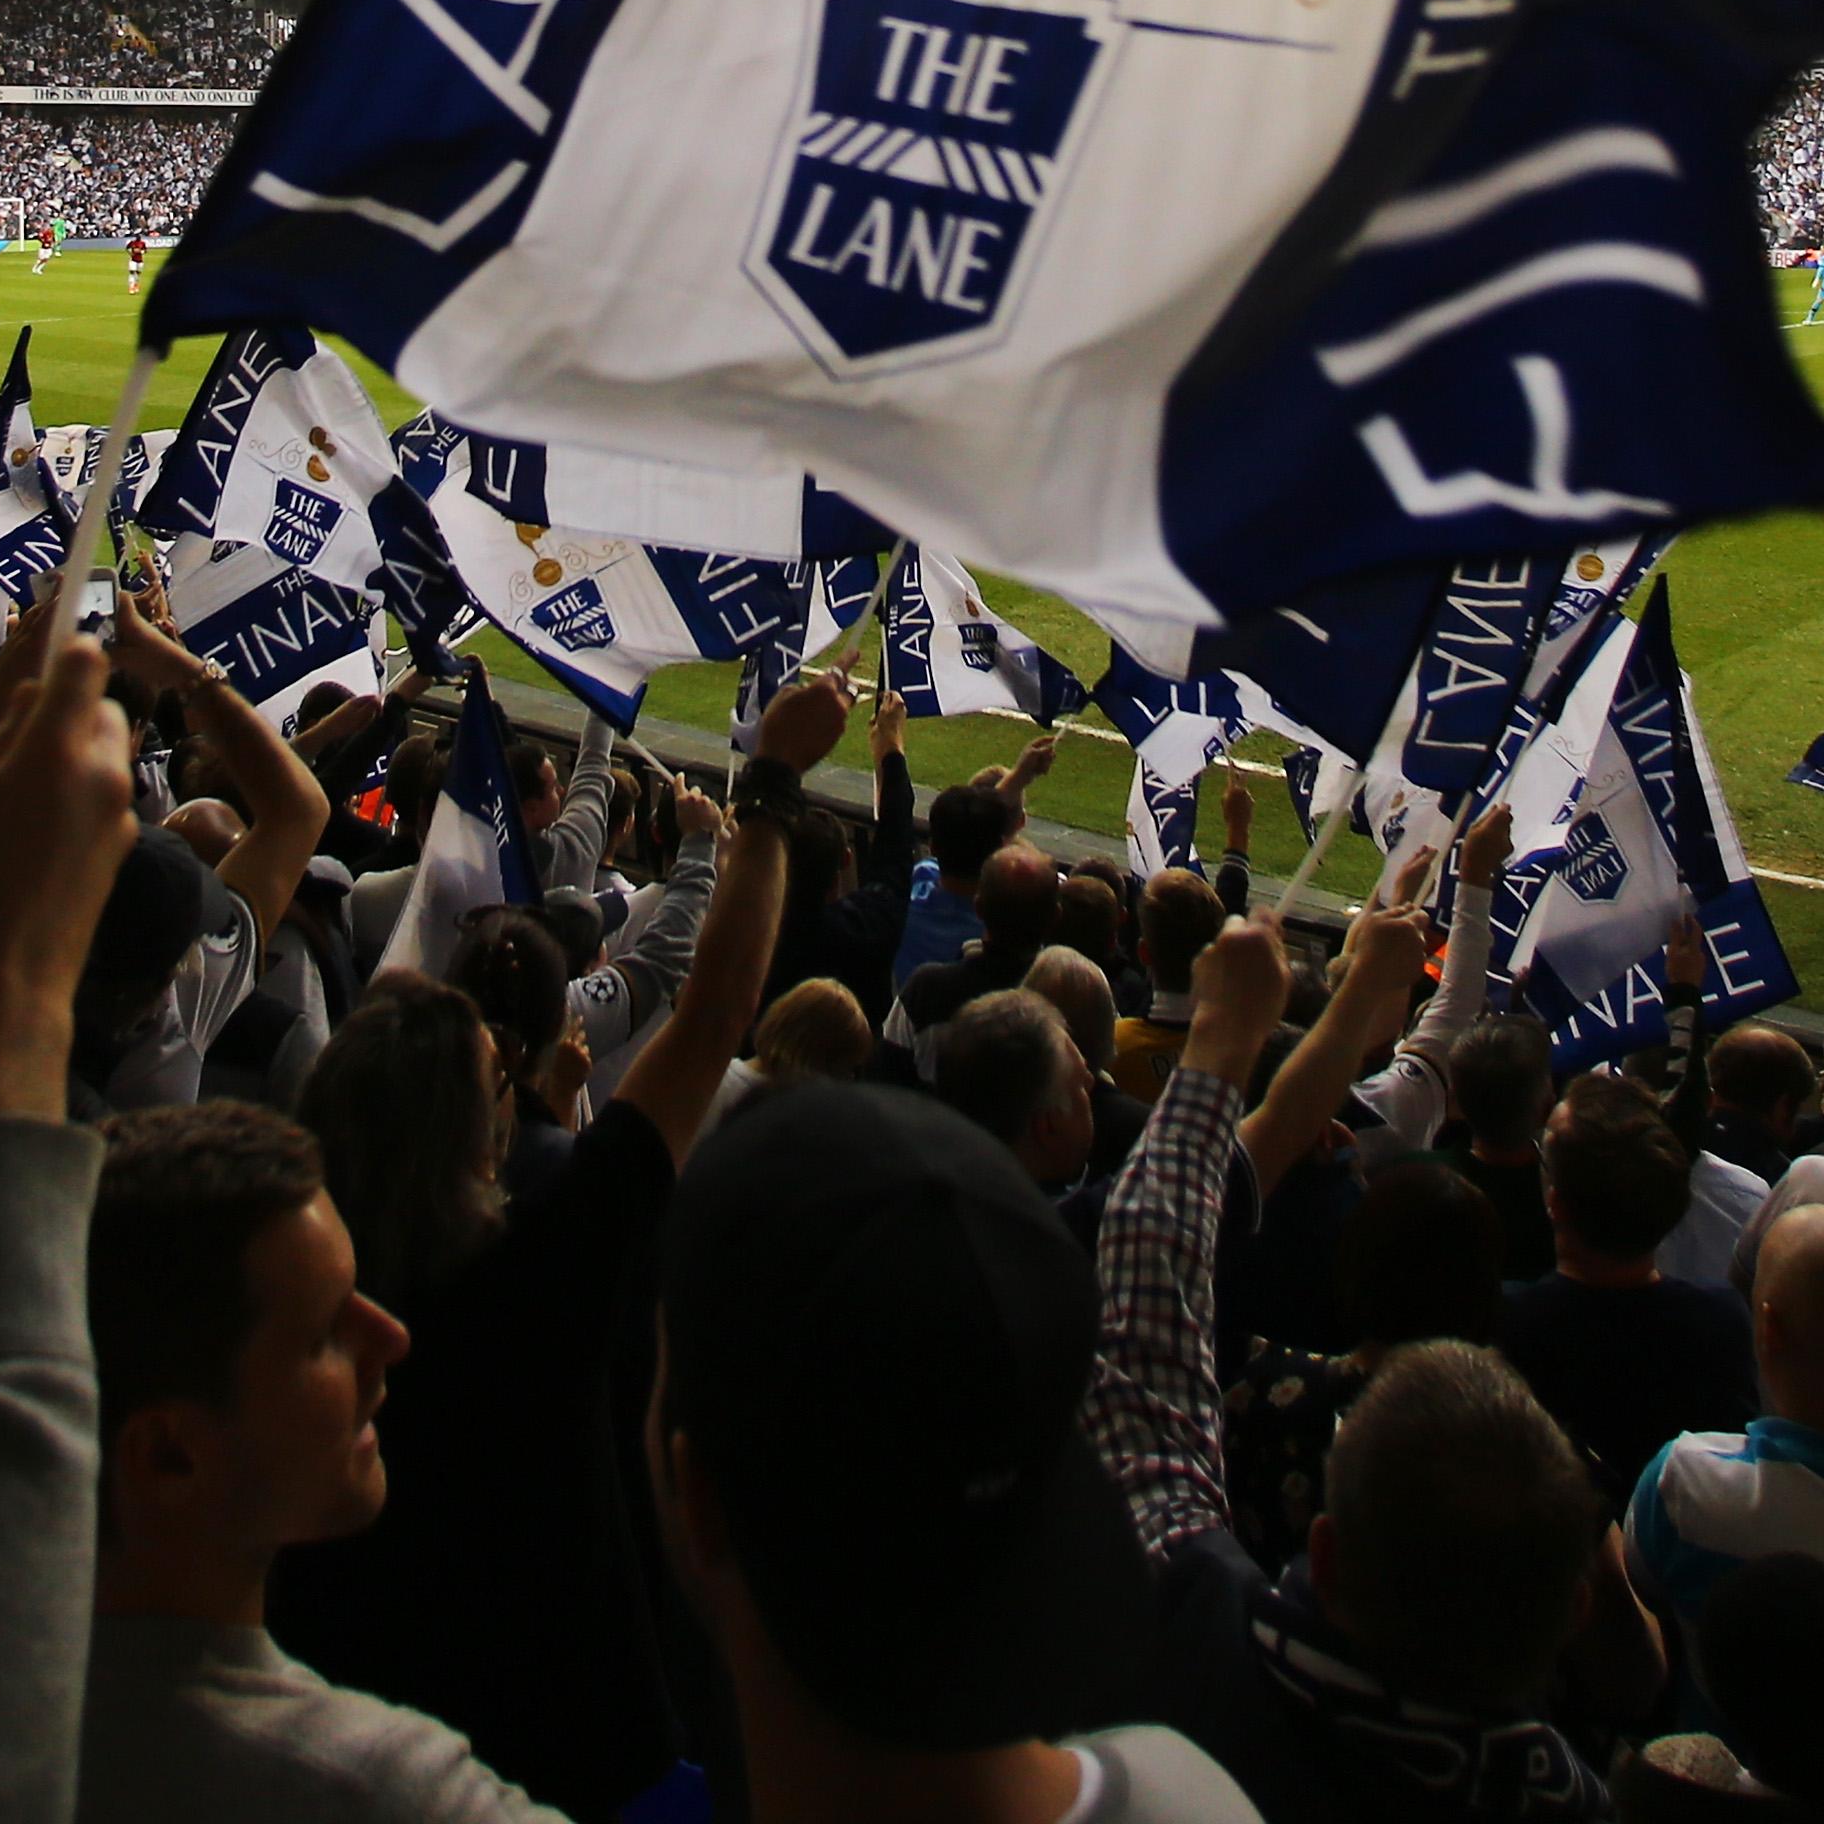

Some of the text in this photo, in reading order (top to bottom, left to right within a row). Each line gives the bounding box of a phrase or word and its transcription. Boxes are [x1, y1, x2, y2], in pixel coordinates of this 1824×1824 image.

[878, 16, 1029, 124] THE
[63, 89, 74, 100] IS
[134, 91, 151, 102] MY
[156, 90, 178, 103] ONE
[182, 91, 204, 103] AND
[208, 91, 238, 104] ONLY
[238, 91, 261, 104] CLU
[788, 183, 1002, 312] LANE
[177, 328, 283, 529] LANE
[289, 489, 326, 524] THE
[267, 524, 318, 563] LANE
[272, 567, 314, 599] THE
[545, 587, 589, 621] THE
[888, 604, 900, 640] THE
[899, 560, 933, 694] LANE
